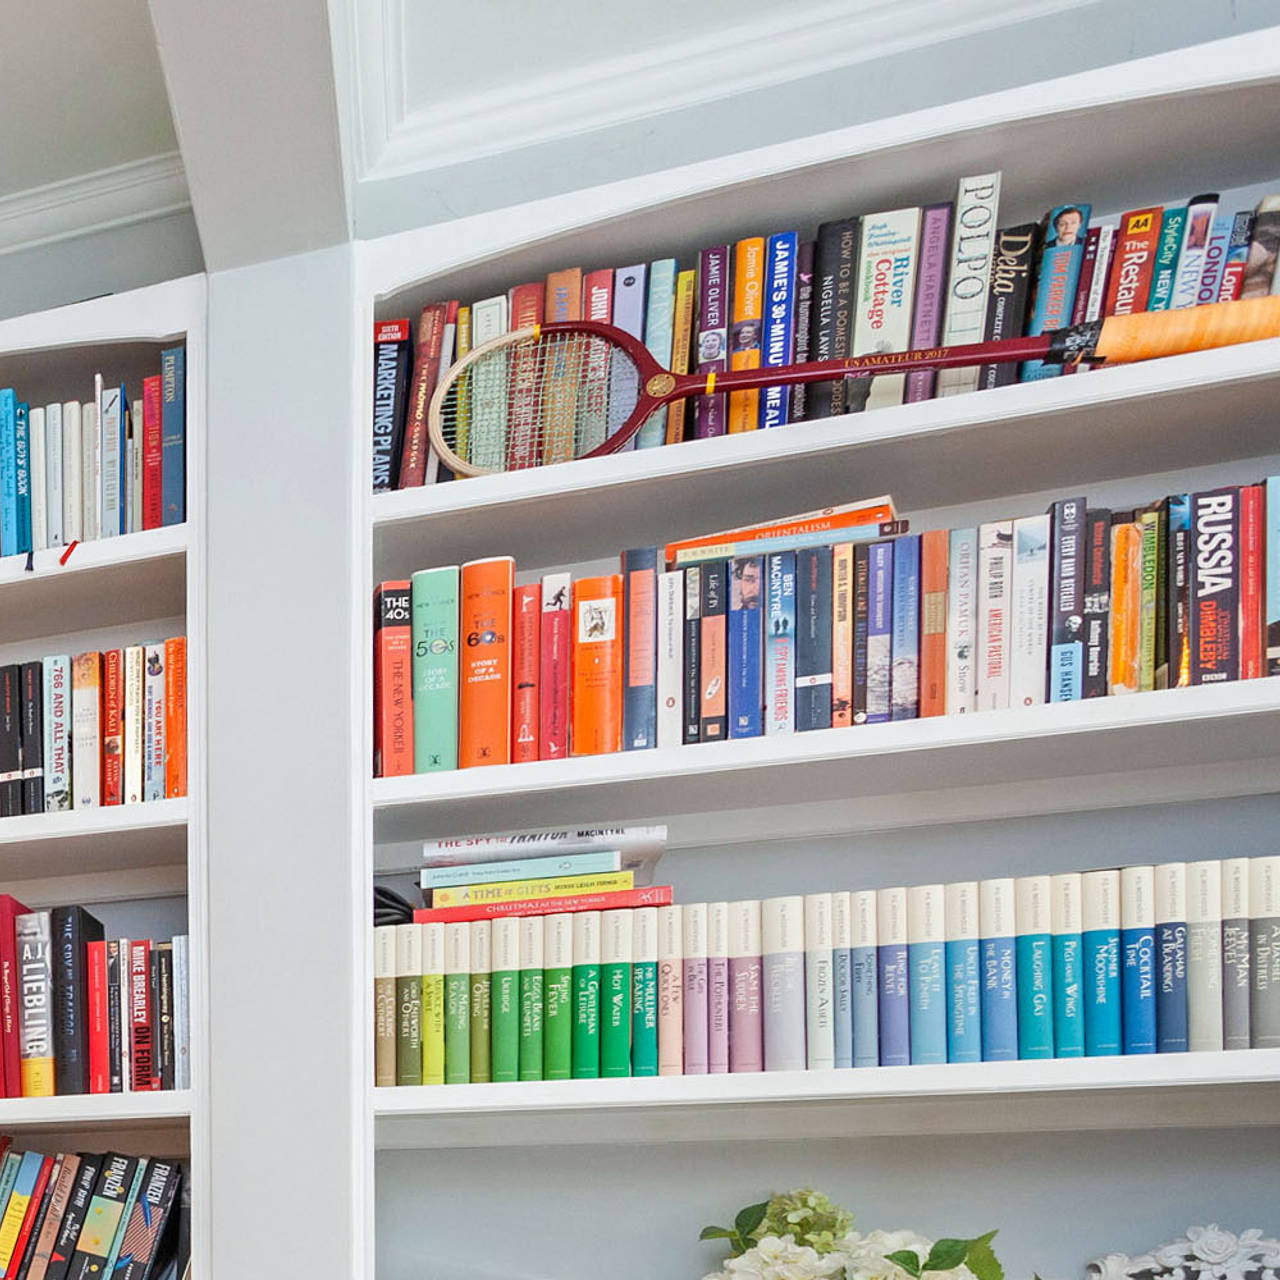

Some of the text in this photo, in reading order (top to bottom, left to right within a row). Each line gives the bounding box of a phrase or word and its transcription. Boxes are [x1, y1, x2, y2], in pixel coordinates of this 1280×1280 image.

[841, 230, 854, 261] HOW
[953, 184, 995, 299] POLPO
[1124, 240, 1149, 251] The
[1129, 216, 1149, 229] AA
[772, 240, 790, 304] JAMIE'S
[839, 263, 851, 279] TO
[890, 255, 911, 307] River
[993, 231, 1033, 294] Delia
[590, 286, 608, 320] JOHN
[706, 253, 721, 327] JAMIE OLIVER
[819, 275, 834, 327] NIGELLA
[866, 259, 893, 329] Cottage
[861, 351, 922, 366] AMATEUR
[924, 348, 950, 360] 2017
[372, 343, 398, 490] MARKETING PLANS
[755, 521, 831, 540] ORIENTALISM
[1143, 521, 1157, 590] WIMBLEDON
[1197, 494, 1232, 598] RUSSIA
[384, 596, 409, 608] THE
[770, 555, 782, 618] MACINTYRE
[782, 573, 793, 596] BEN
[384, 608, 410, 621] 40s
[467, 630, 505, 647] 60s
[1199, 601, 1215, 670] DIMBLEBY
[53, 692, 65, 719] AND
[391, 660, 404, 754] THE NEW YORKER
[54, 721, 65, 744] ALL
[54, 745, 66, 775] THAT
[1126, 942, 1140, 968] TIME
[1138, 935, 1154, 1000] COCKTAIL
[1174, 926, 1187, 979] GALAHAD
[22, 962, 48, 1057] LIEBLING
[132, 945, 153, 1087] MIKE BREARLEY ON FORM
[611, 969, 623, 1028] HOT WATER
[102, 1157, 129, 1198] FRANZEN
[146, 1162, 171, 1205] FRANZEN
